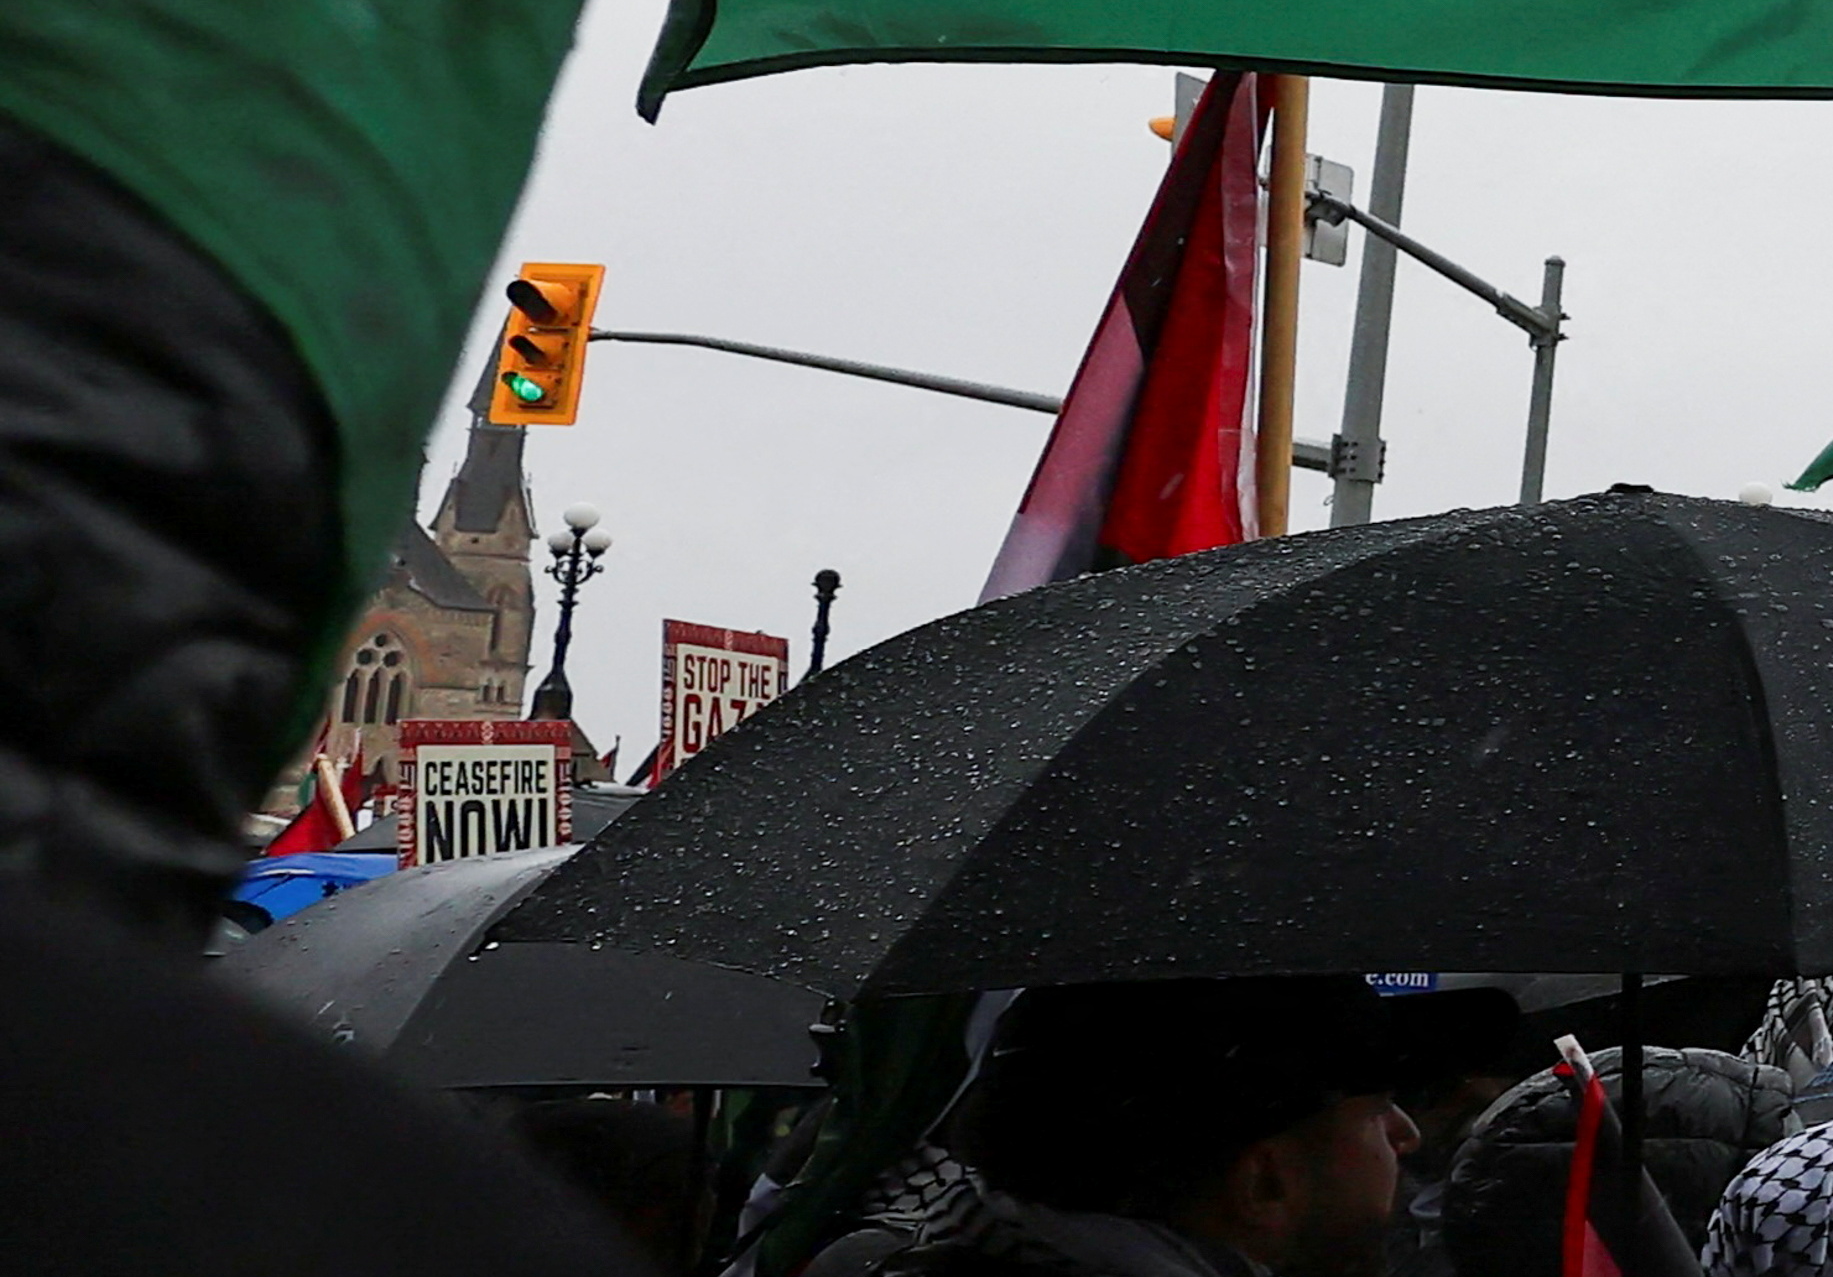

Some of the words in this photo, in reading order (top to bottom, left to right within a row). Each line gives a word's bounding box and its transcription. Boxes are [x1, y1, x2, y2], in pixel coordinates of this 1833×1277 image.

[684, 654, 730, 693] STOP
[738, 661, 772, 700] THE
[683, 692, 764, 754] GAZ
[425, 760, 547, 795] CEASEFIRE
